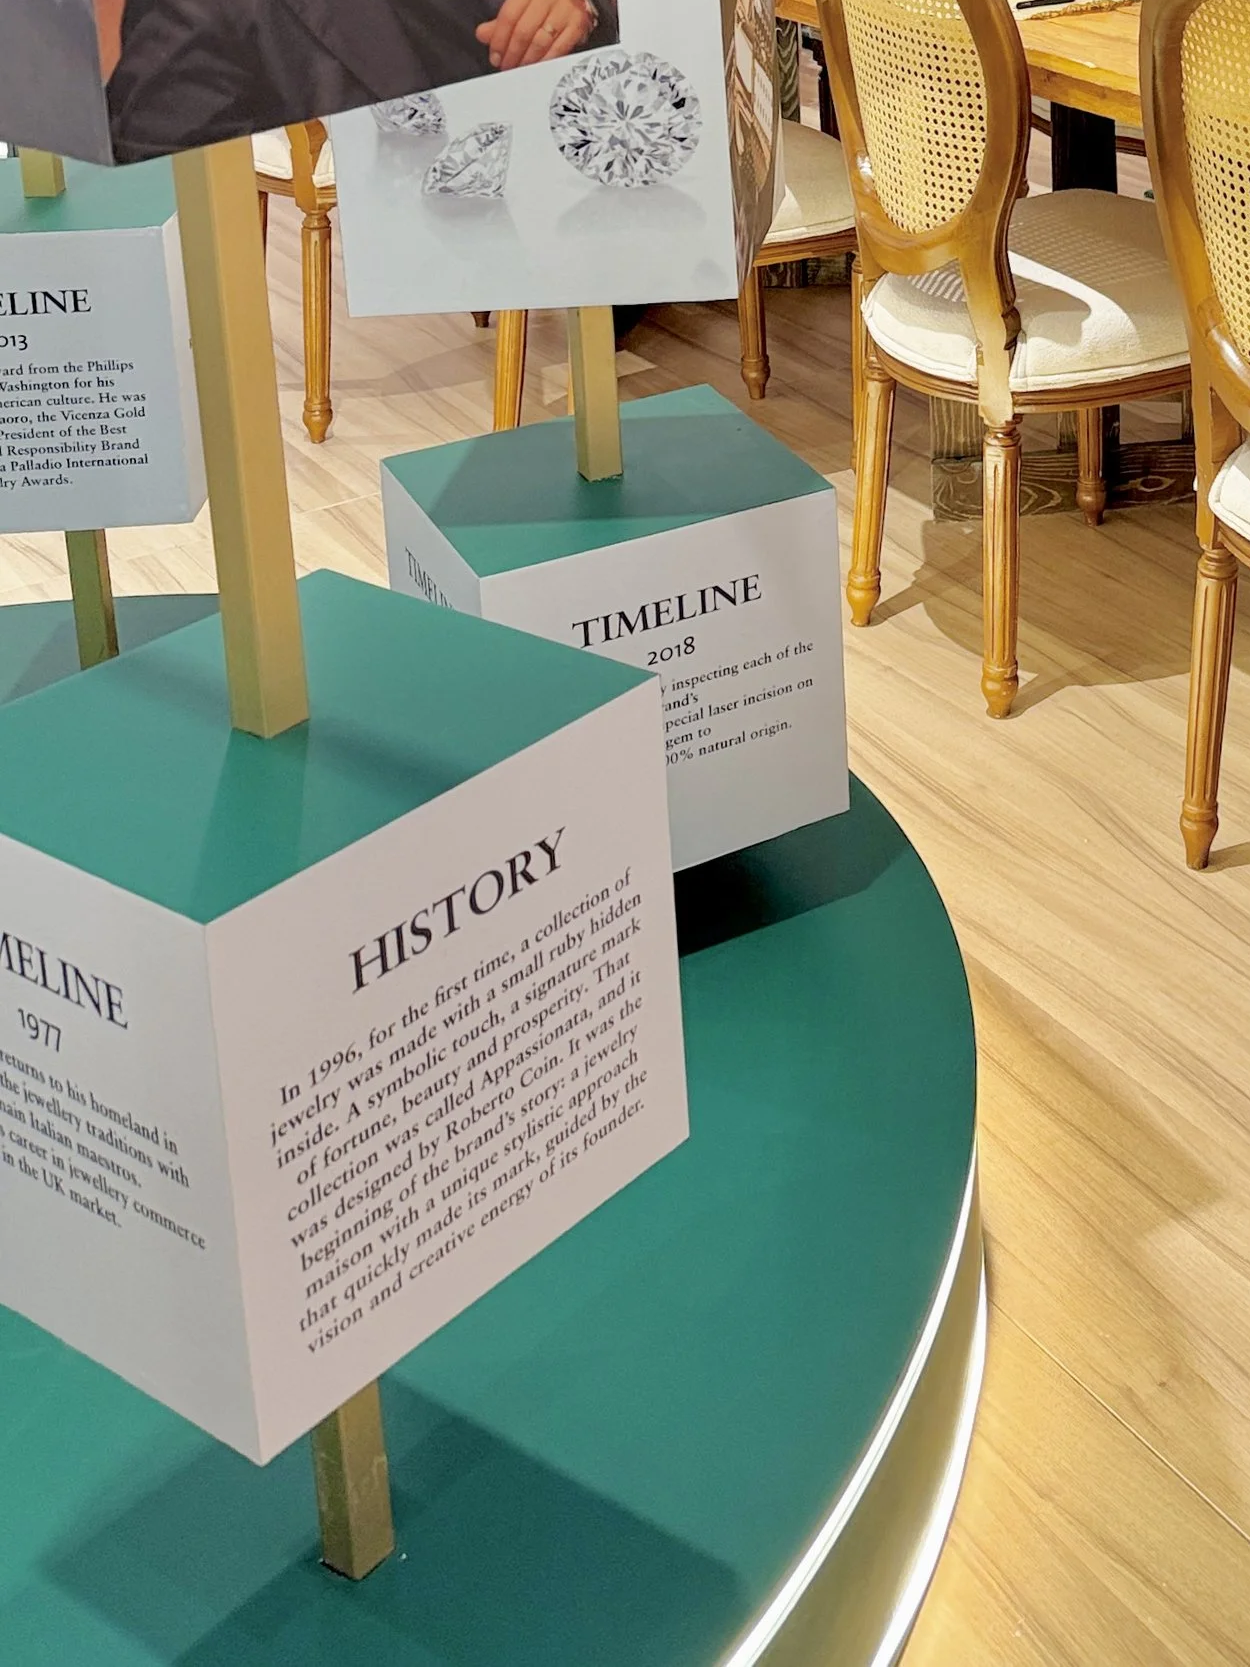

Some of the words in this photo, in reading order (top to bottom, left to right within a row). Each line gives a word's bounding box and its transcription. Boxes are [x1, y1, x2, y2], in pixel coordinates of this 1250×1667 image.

[0, 364, 23, 376] ard
[28, 363, 59, 374] from
[63, 361, 82, 372] the
[87, 359, 133, 373] Phillips
[0, 398, 41, 408] erican
[46, 393, 94, 405] culture.
[98, 391, 117, 403] He
[121, 393, 145, 401] was
[73, 377, 92, 388] for
[96, 376, 114, 387] his
[6, 441, 96, 457] Responsibility
[100, 437, 139, 450] Brand
[36, 411, 56, 422] the
[59, 409, 110, 420] Vicenza
[113, 405, 145, 418] Gold
[58, 425, 72, 437] of
[75, 425, 96, 436] the
[99, 424, 126, 435] Best
[10, 458, 62, 471] Palladio
[66, 453, 148, 468] International
[21, 473, 72, 487] Awards.
[571, 573, 761, 648] TIMELINE
[647, 635, 695, 665] 2018
[672, 664, 739, 691] inspecting
[742, 651, 771, 670] each
[776, 645, 789, 660] of
[794, 641, 812, 655] the
[664, 692, 698, 711] and's
[697, 727, 711, 738] to
[708, 700, 739, 716] laser
[743, 684, 792, 706] incision
[796, 678, 812, 689] on
[698, 730, 745, 756] natural
[750, 721, 791, 739] origin.
[349, 826, 564, 993] HISTORY
[271, 1087, 340, 1146] jewelry
[347, 1060, 382, 1090] was
[389, 1025, 436, 1065] made
[442, 994, 480, 1028] with
[486, 987, 495, 1002] a
[501, 950, 543, 992] small
[549, 929, 584, 961] ruby
[589, 894, 641, 934] hidden
[280, 1084, 300, 1105] In
[309, 1044, 362, 1087] 1996,
[368, 1022, 395, 1049] for
[401, 1002, 428, 1028] the
[434, 976, 467, 1007] first
[473, 950, 515, 982] time,
[520, 938, 529, 952] a
[534, 887, 609, 942] collection
[614, 866, 630, 891] of
[17, 1008, 61, 1052] 1977
[277, 1122, 339, 1168] inside.
[346, 1101, 361, 1123] A
[367, 1047, 446, 1109] symbolic
[452, 1009, 505, 1052] touch,
[510, 1000, 519, 1014] a
[524, 949, 596, 1004] signature
[601, 917, 640, 954] mark
[296, 1155, 316, 1184] of
[323, 1113, 396, 1168] fortune,
[401, 1065, 460, 1114] beauty
[466, 1035, 497, 1071] and
[503, 984, 588, 1052] prosperity.
[592, 952, 629, 983] That
[0, 1070, 20, 1095] the
[22, 1081, 81, 1132] jewellery
[85, 1120, 153, 1168] traditions
[156, 1160, 189, 1187] with
[48, 1075, 63, 1093] to
[66, 1078, 86, 1106] his
[89, 1091, 159, 1145] homeland
[163, 1137, 178, 1155] in
[287, 1151, 378, 1221] collection
[384, 1123, 419, 1153] was
[425, 1079, 474, 1127] called
[480, 1008, 592, 1090] Appassionata,
[598, 976, 625, 1009] and
[630, 970, 640, 986] it
[290, 1215, 327, 1247] was
[334, 1149, 412, 1218] designed
[418, 1136, 439, 1160] by
[445, 1086, 514, 1142] Roberto
[519, 1055, 563, 1087] Coin.
[568, 1037, 579, 1055] It
[585, 1015, 614, 1042] was
[619, 997, 641, 1020] the
[29, 1110, 72, 1150] Italian
[76, 1142, 141, 1188] maestros.
[300, 1198, 393, 1271] beginning
[398, 1173, 416, 1202] of
[422, 1158, 449, 1186] the
[454, 1110, 515, 1163] brand's
[520, 1077, 564, 1116] story:
[570, 1067, 579, 1081] a
[584, 1025, 637, 1076] jewelry
[305, 1242, 372, 1298] maison
[379, 1205, 419, 1243] with
[425, 1197, 435, 1212] a
[441, 1151, 498, 1200] unique
[503, 1104, 563, 1156] stylistic
[568, 1048, 637, 1109] approach
[2, 1150, 14, 1166] in
[17, 1156, 38, 1180] the
[41, 1166, 65, 1195] UK
[69, 1189, 121, 1227] market.
[8, 1129, 47, 1160] career
[51, 1153, 65, 1170] in
[68, 1162, 128, 1209] jewellery
[132, 1199, 205, 1250] commerce
[299, 1295, 336, 1331] that
[343, 1242, 409, 1301] quickly
[416, 1205, 462, 1247] made
[467, 1186, 486, 1209] its
[492, 1150, 540, 1191] mark,
[545, 1101, 596, 1157] guided
[600, 1089, 619, 1111] by
[624, 1070, 646, 1094] the
[307, 1307, 363, 1352] vision
[369, 1270, 402, 1310] and
[409, 1223, 474, 1279] creative
[480, 1179, 533, 1226] energy
[538, 1156, 555, 1182] of
[560, 1146, 577, 1168] its
[583, 1099, 644, 1151] founder.
